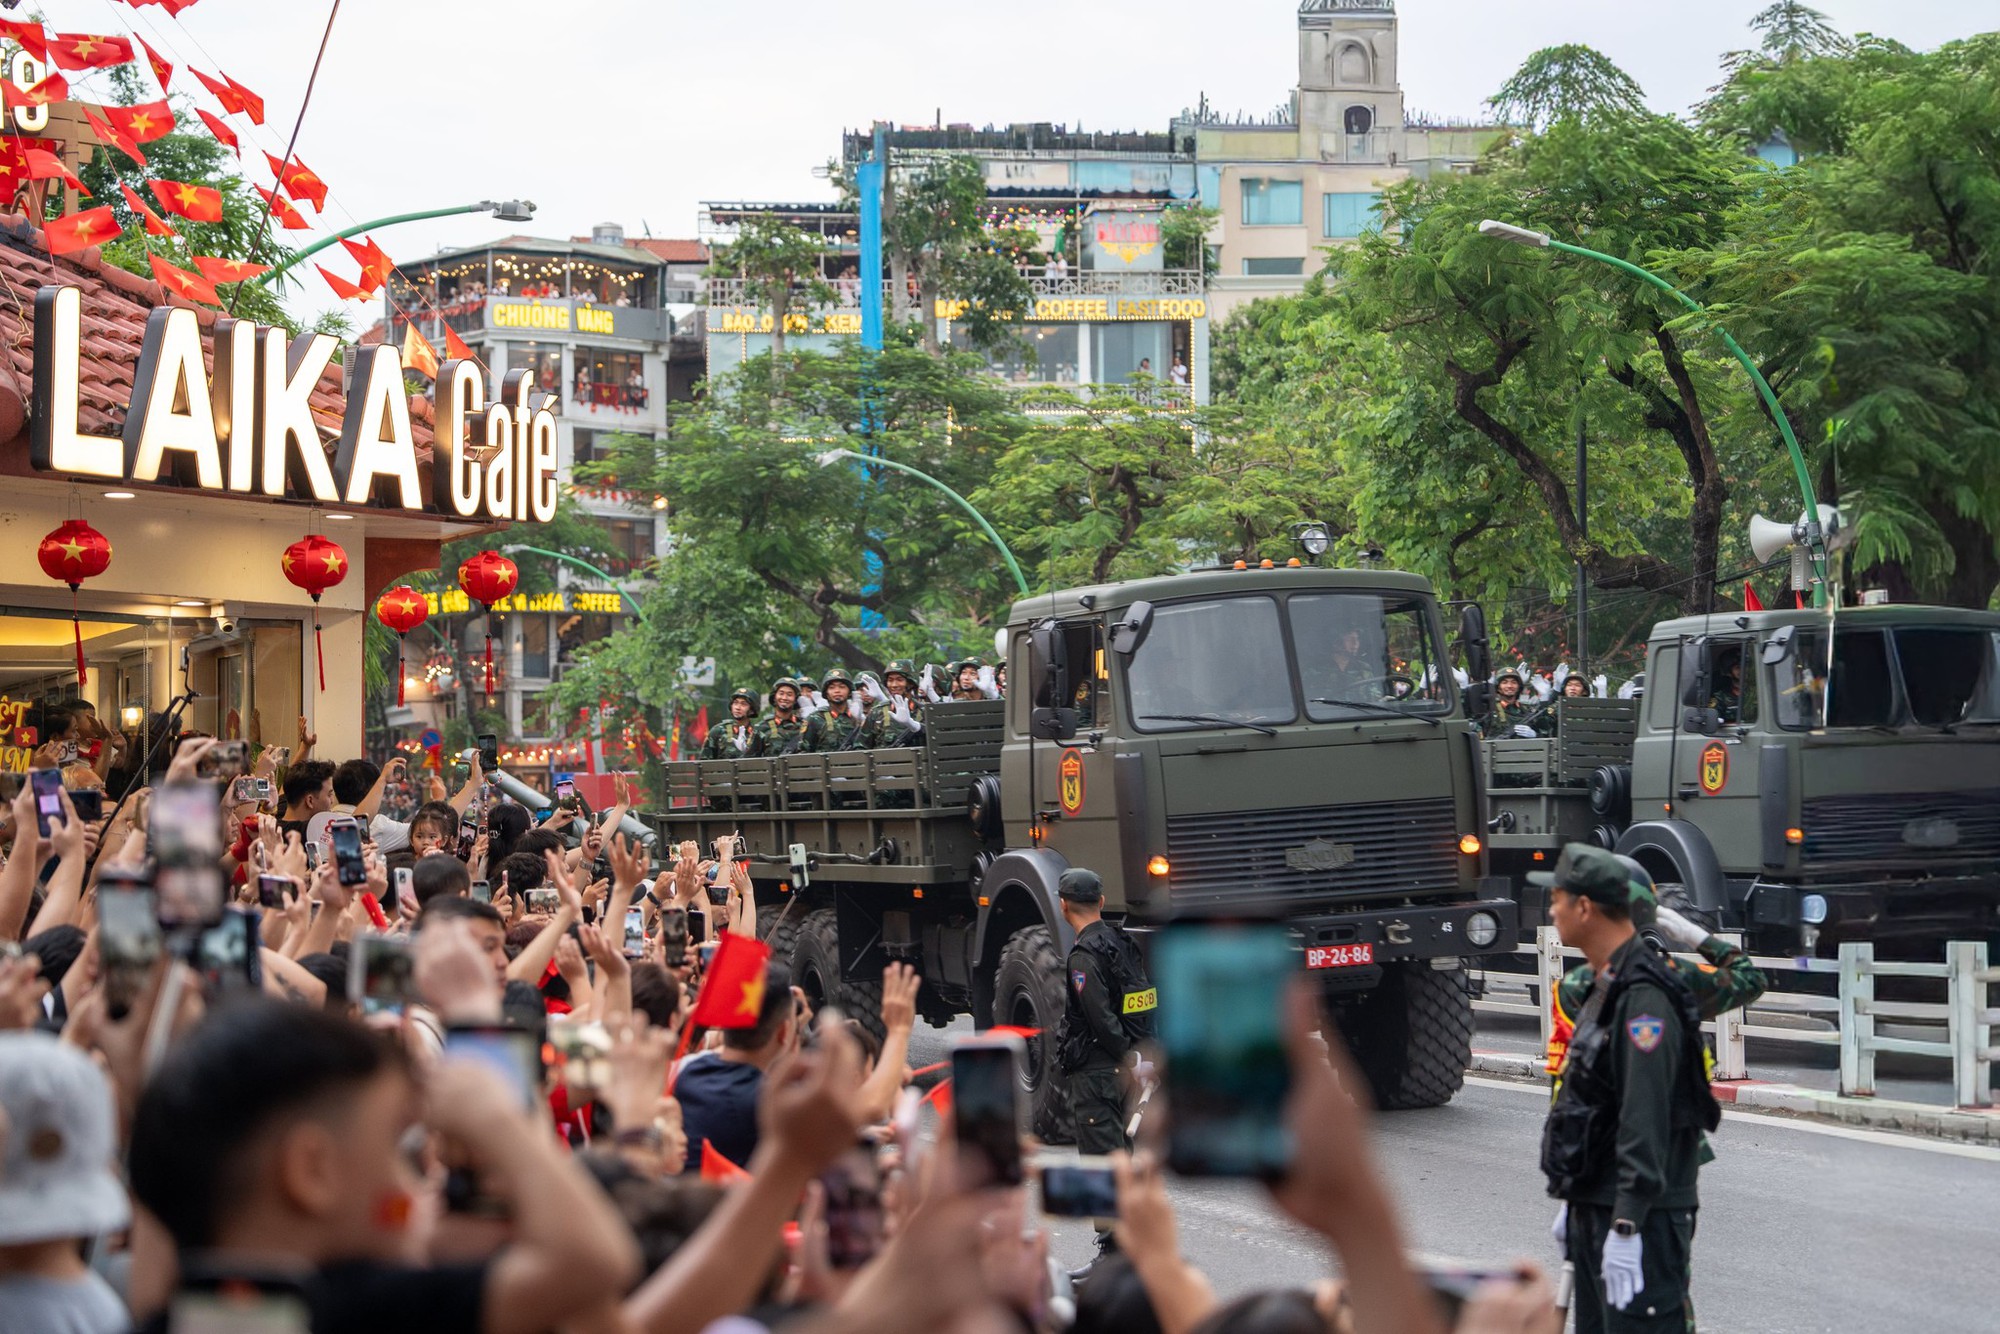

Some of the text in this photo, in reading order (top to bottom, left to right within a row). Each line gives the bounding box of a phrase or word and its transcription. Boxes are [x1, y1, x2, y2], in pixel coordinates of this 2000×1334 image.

[493, 299, 569, 328] CHUÔNG
[1035, 298, 1108, 318] COFFEE
[1117, 298, 1206, 318] FASTFOOD
[49, 285, 560, 523] LAIKA Café
[1308, 946, 1371, 966] BP-26-86
